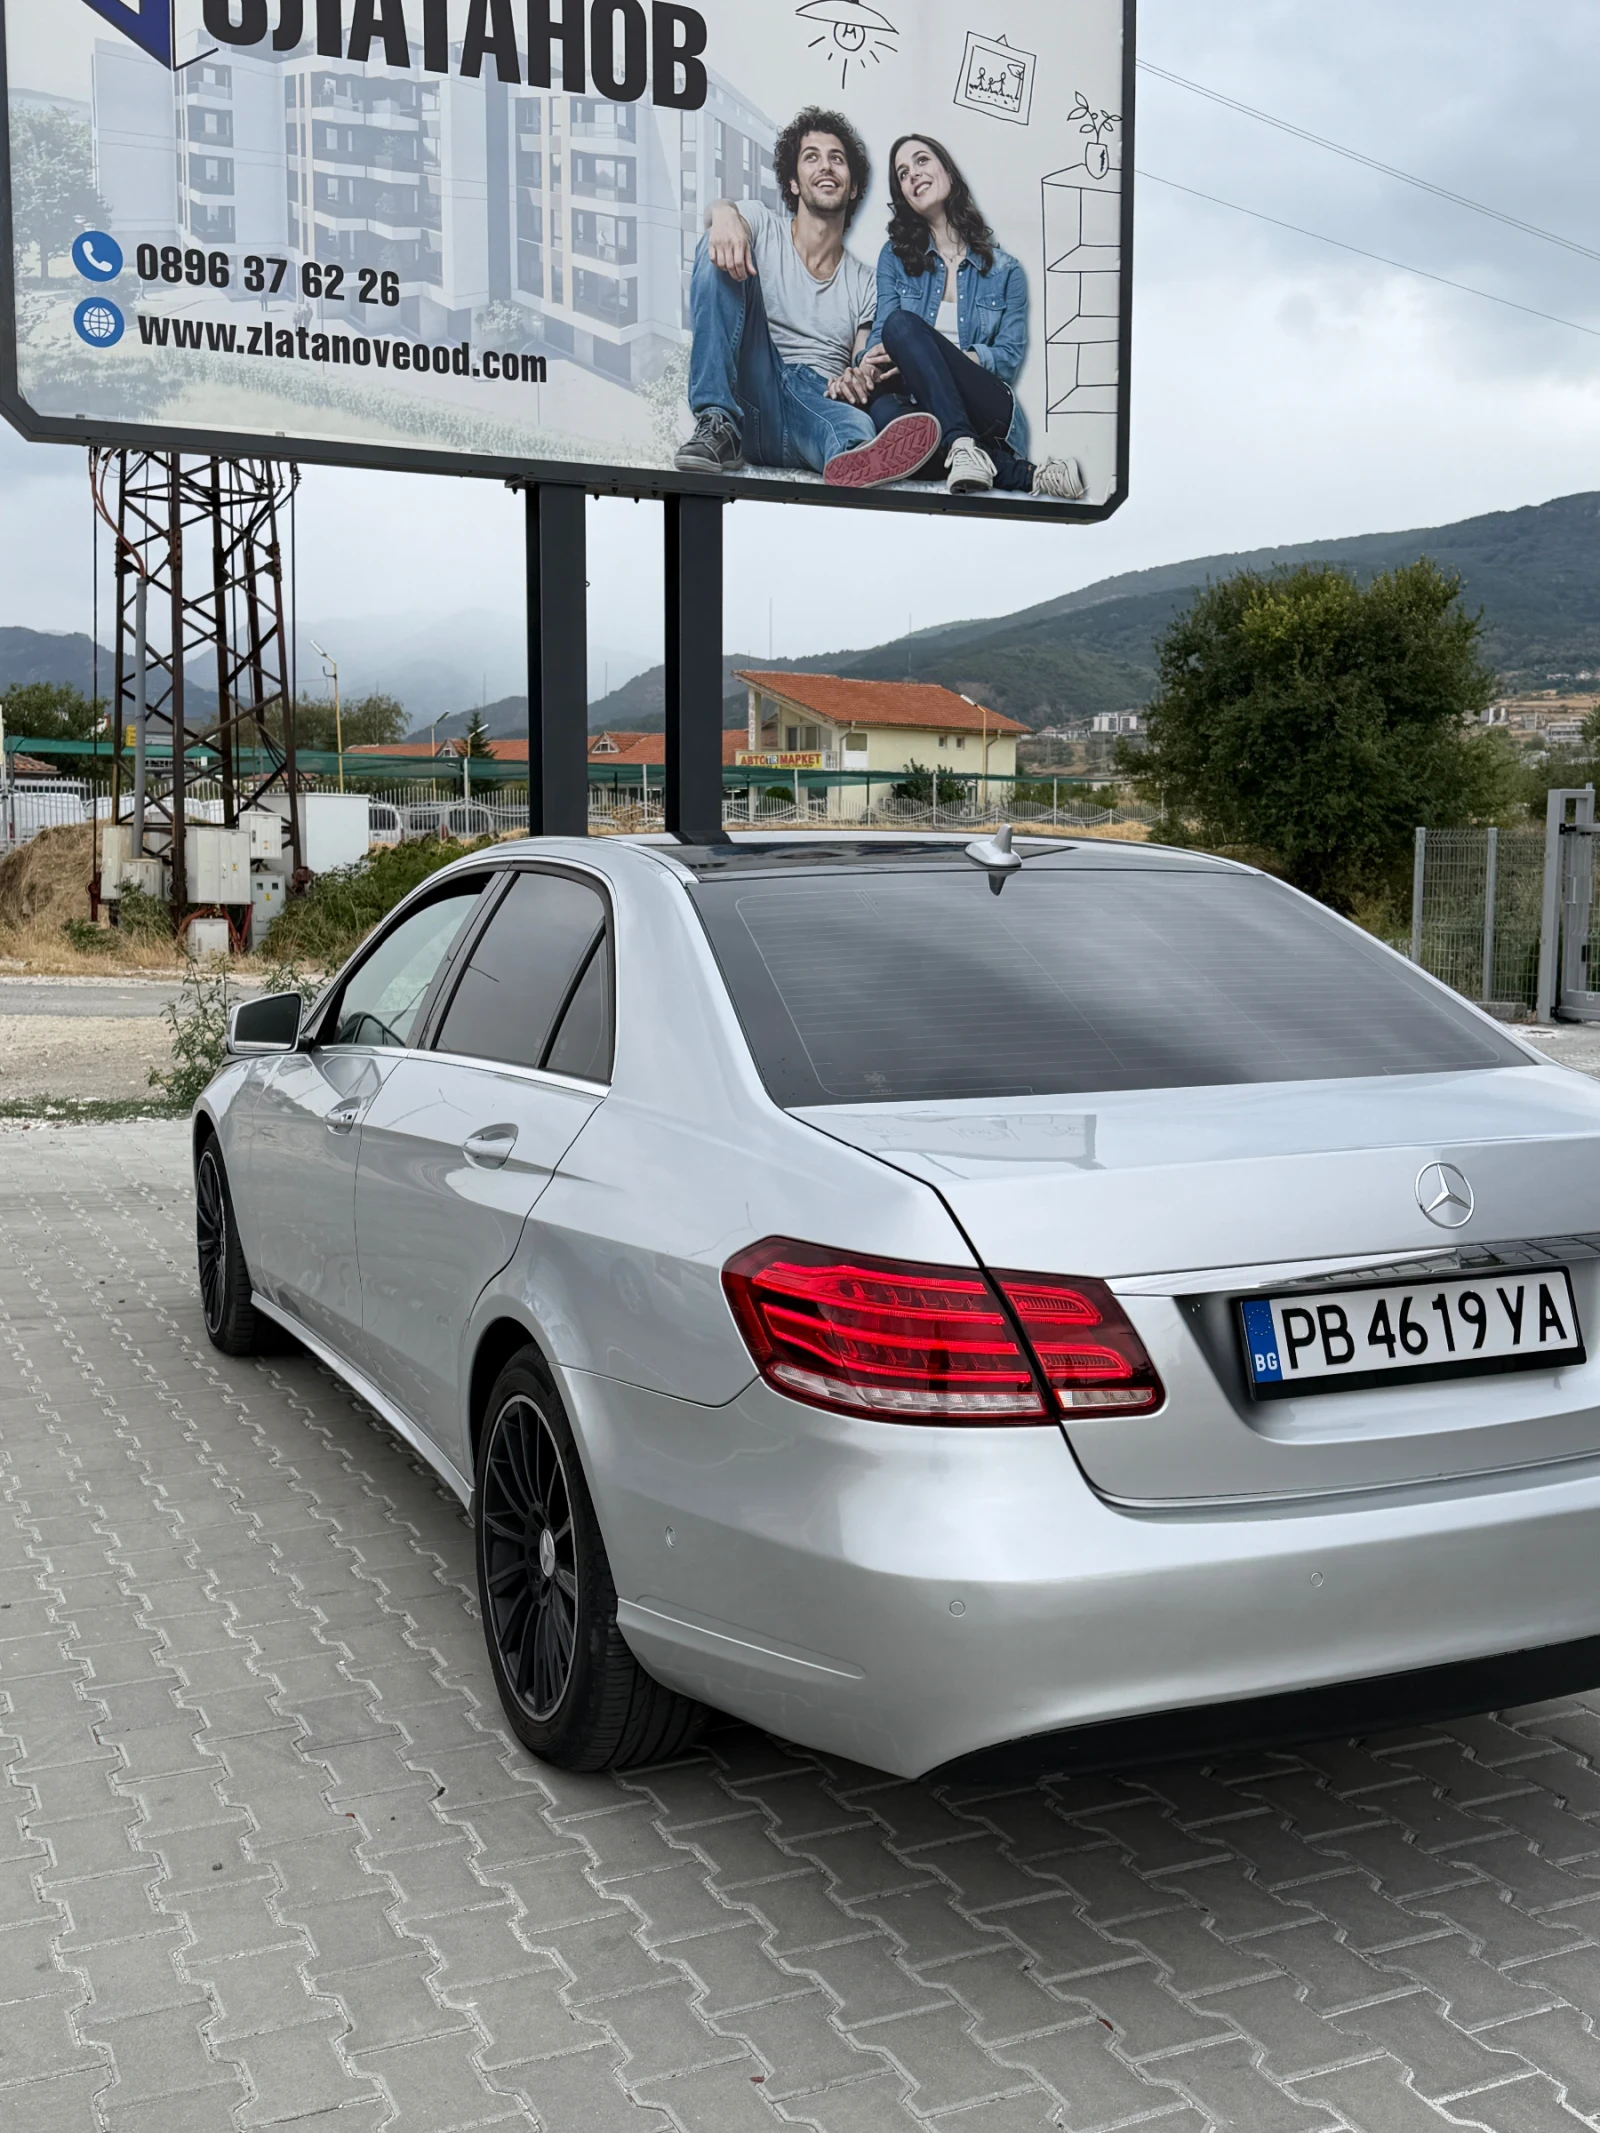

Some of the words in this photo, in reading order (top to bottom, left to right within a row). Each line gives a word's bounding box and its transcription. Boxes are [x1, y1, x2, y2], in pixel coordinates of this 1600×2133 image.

[136, 243, 230, 289] 0896
[243, 255, 288, 294] 37
[301, 261, 345, 301] 62
[358, 268, 400, 307] 26
[137, 315, 547, 383] www.zlatanoveood.com
[780, 753, 821, 765] МАРКЕТ
[1254, 1352, 1278, 1372] BG
